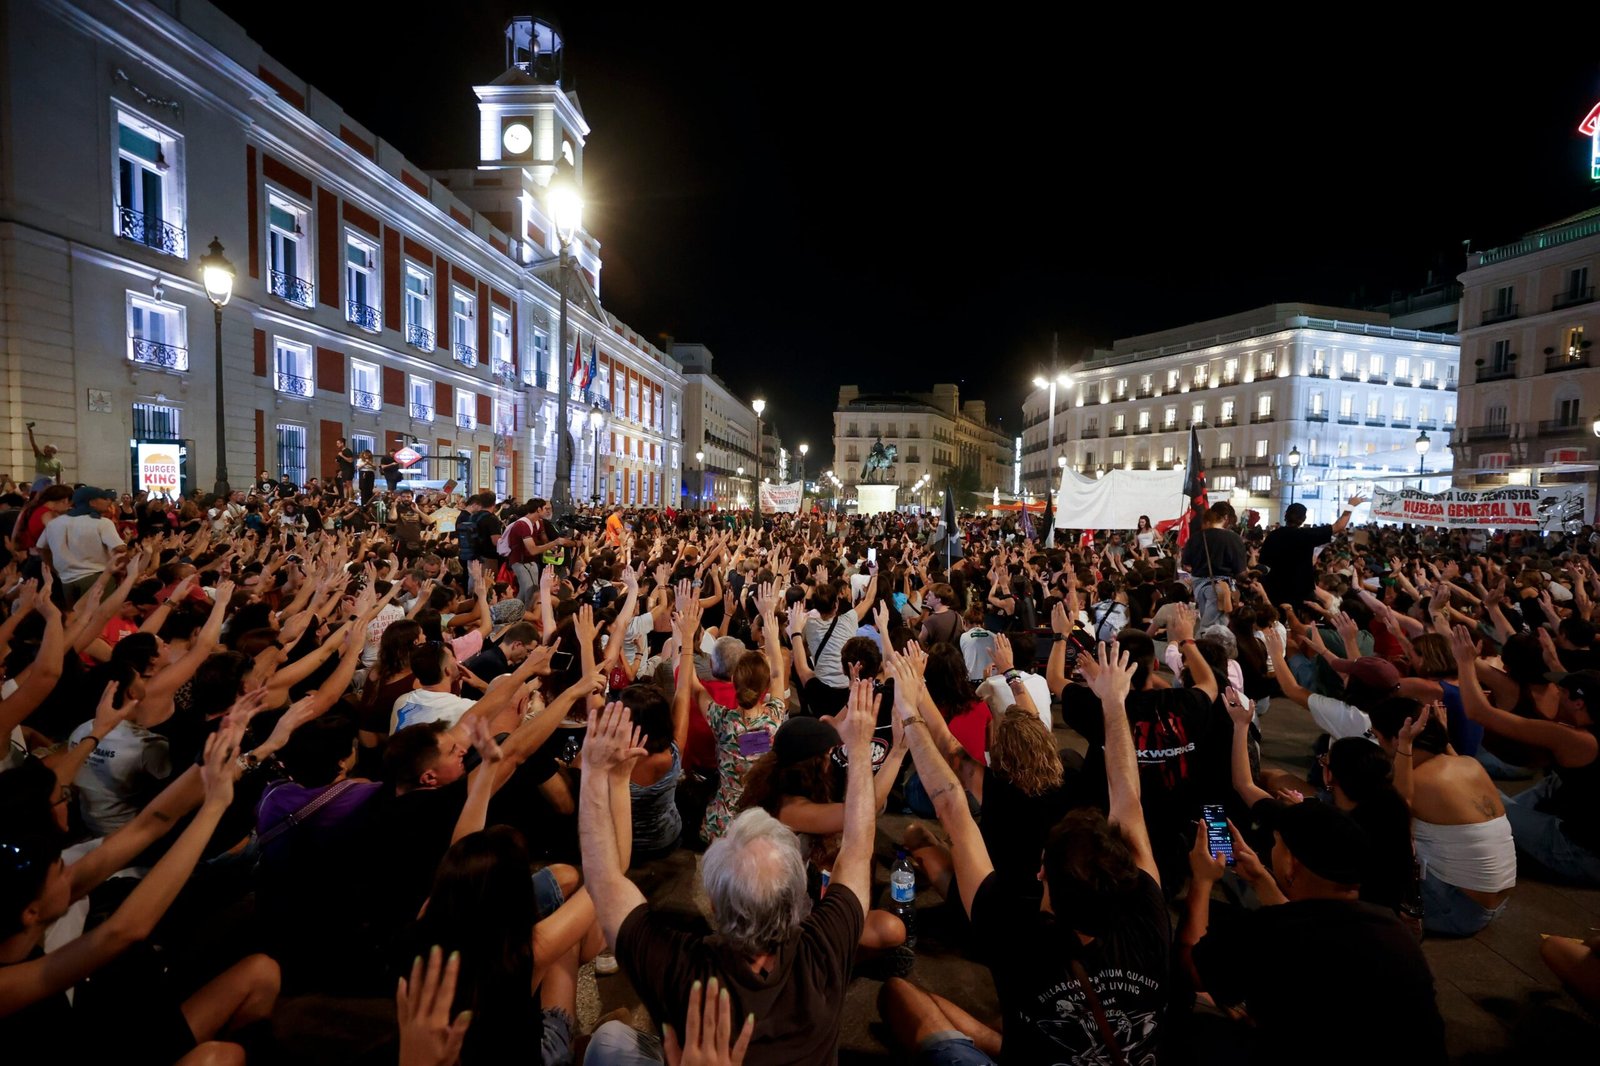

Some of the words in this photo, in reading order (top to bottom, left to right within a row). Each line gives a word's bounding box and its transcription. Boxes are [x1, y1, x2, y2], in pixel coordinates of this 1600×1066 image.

[144, 465, 176, 473] BURGER
[144, 473, 176, 484] KING
[1456, 491, 1477, 502] LOS
[1403, 500, 1444, 515] HUELGA
[1448, 502, 1508, 517] GENERAL
[1513, 502, 1532, 516] YA
[1037, 979, 1082, 1004] BILLABON
[1088, 968, 1123, 985] PRMIUM
[1109, 981, 1140, 995] LIVING
